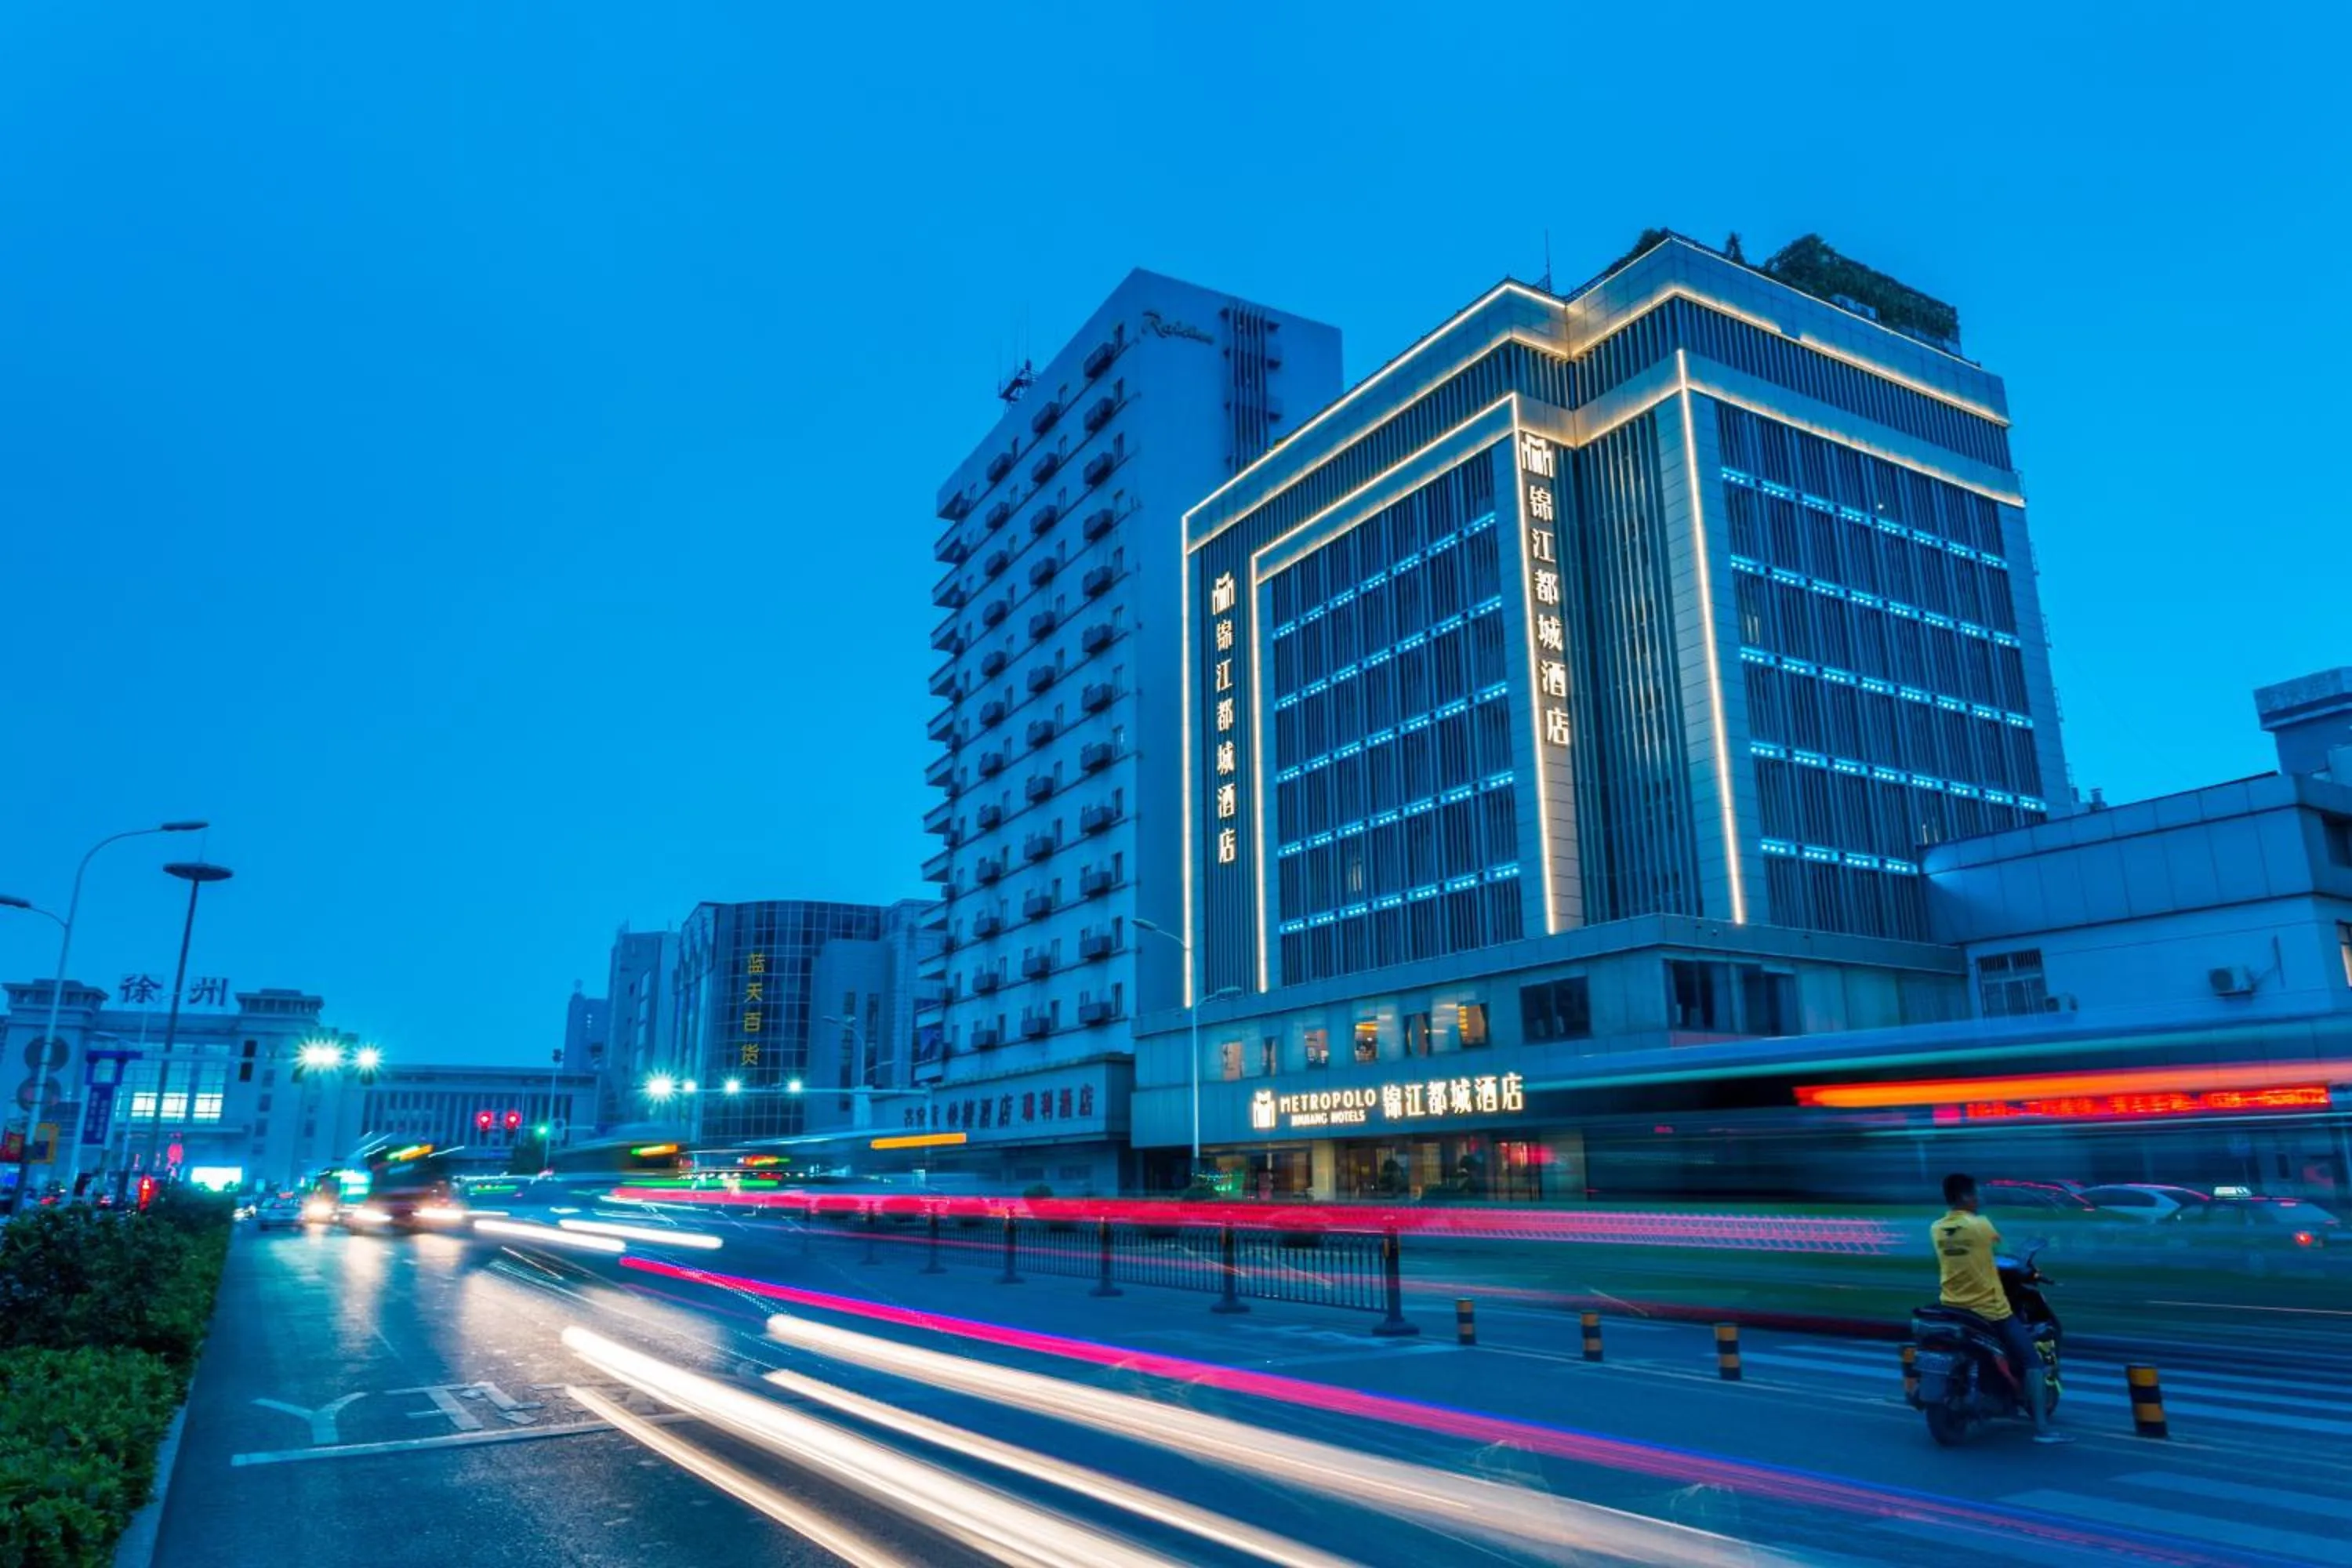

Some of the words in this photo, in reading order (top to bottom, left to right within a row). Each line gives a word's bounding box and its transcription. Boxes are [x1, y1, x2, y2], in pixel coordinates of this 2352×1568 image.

[1529, 485, 1570, 746] 锦江都城酒店
[1215, 619, 1236, 863] 锦江都城酒店
[119, 975, 229, 1007] 徐州
[740, 953, 766, 1066] 蓝天百货
[1279, 1088, 1377, 1113] METROPOLO
[1330, 1109, 1366, 1123] HOTELS
[1382, 1072, 1523, 1120] 锦江都城酒店
